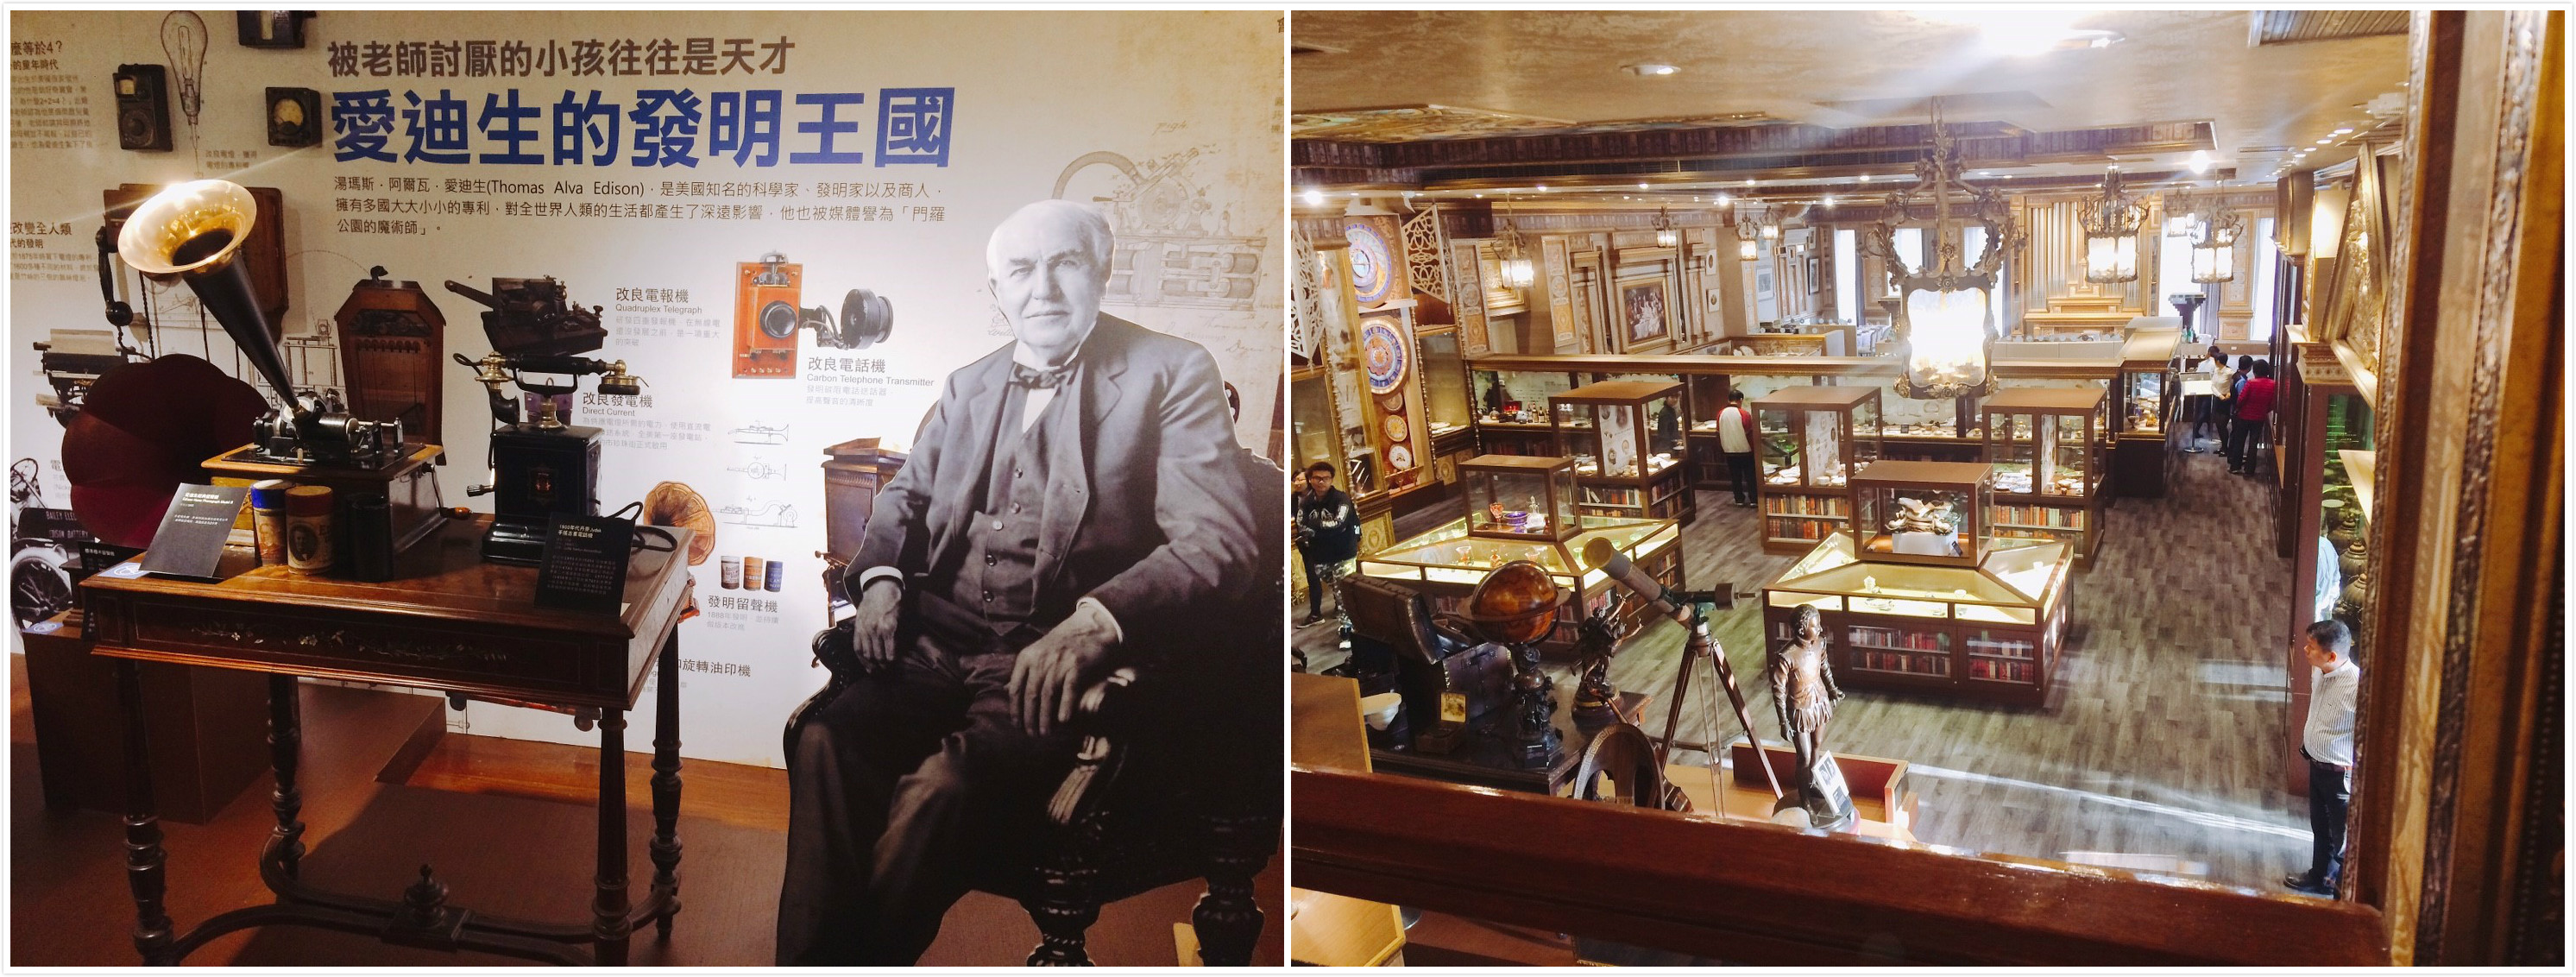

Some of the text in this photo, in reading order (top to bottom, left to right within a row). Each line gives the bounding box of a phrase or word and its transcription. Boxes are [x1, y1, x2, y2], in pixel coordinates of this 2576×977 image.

[10, 59, 59, 70] 的童年時代
[327, 36, 796, 78] 被老師討厭的小孩往往是天才
[331, 87, 955, 168] 愛迪生的發明王國
[553, 180, 583, 195] Alva
[10, 221, 72, 236] 改變全人類
[615, 287, 689, 304] 改良電報機
[615, 303, 703, 315] Quadruplex Telegraph
[808, 356, 886, 374] 改良電話機
[807, 373, 935, 387] Carbon Telephone Transmitter
[583, 392, 653, 409] 改良發電機
[582, 407, 635, 417] Direct Current
[708, 596, 778, 613] 發明留聲機
